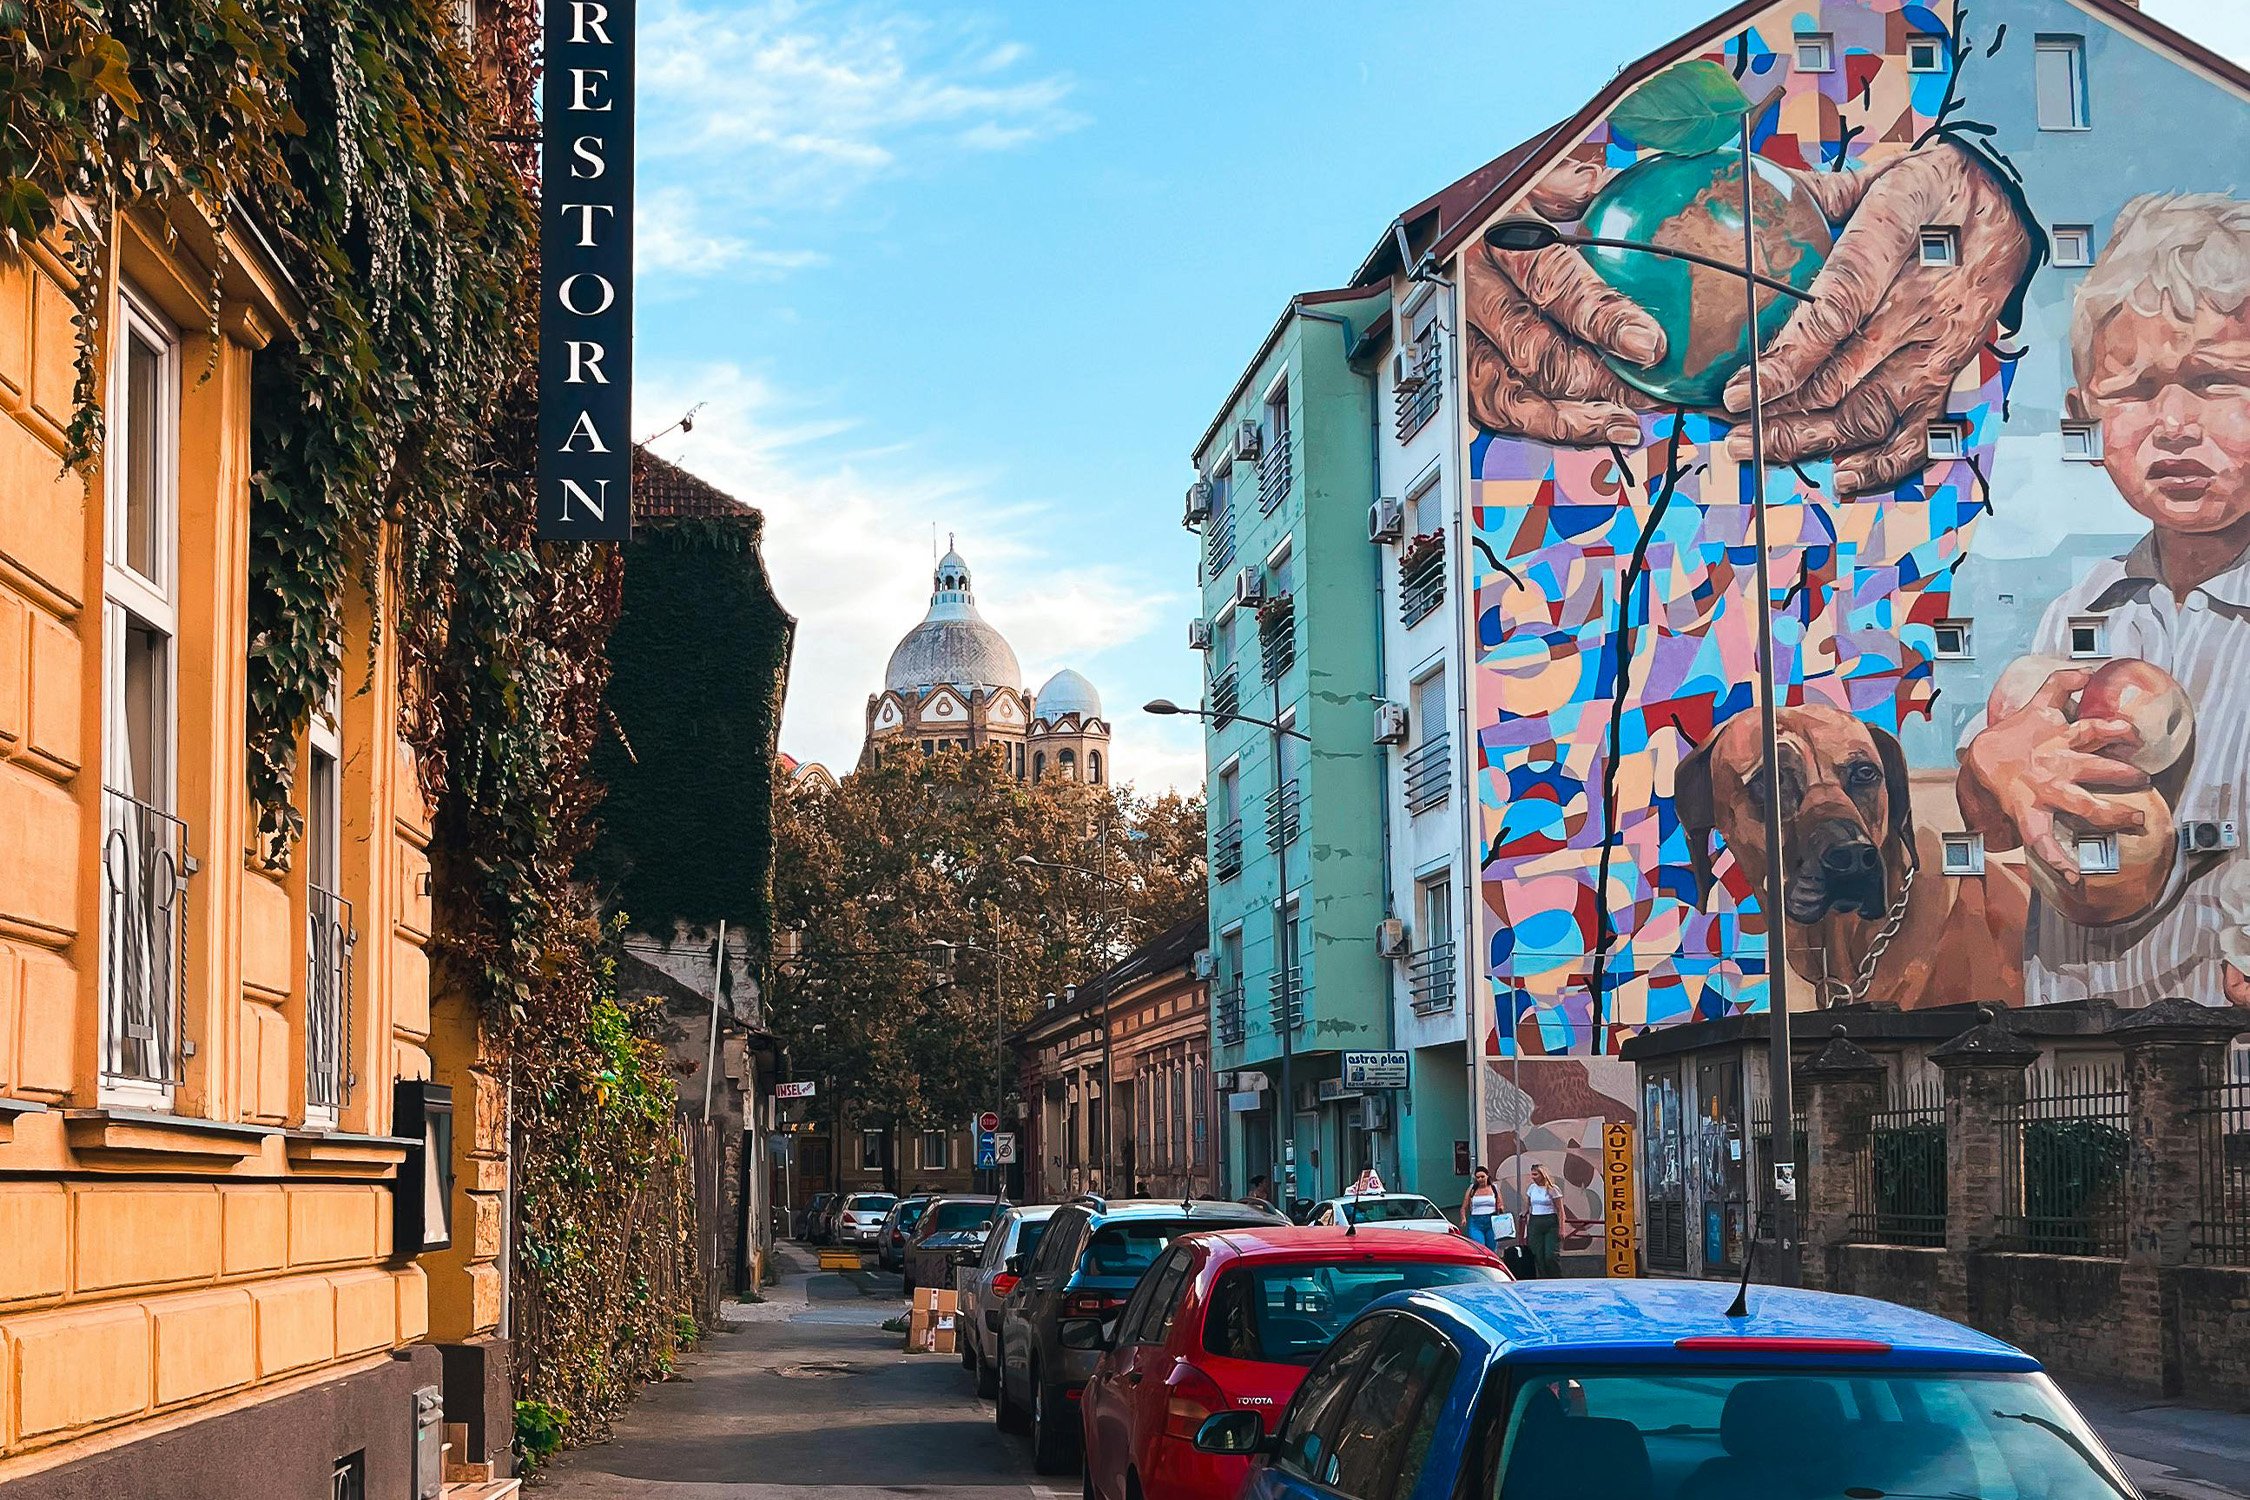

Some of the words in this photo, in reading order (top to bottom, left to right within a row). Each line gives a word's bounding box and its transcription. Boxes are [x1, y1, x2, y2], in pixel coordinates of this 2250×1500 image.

[558, 1, 615, 522] RESTORAN
[1348, 1054, 1377, 1064] astra
[1381, 1053, 1405, 1066] plan
[777, 1084, 802, 1097] INSEL
[1237, 1397, 1273, 1405] TOYOTA
